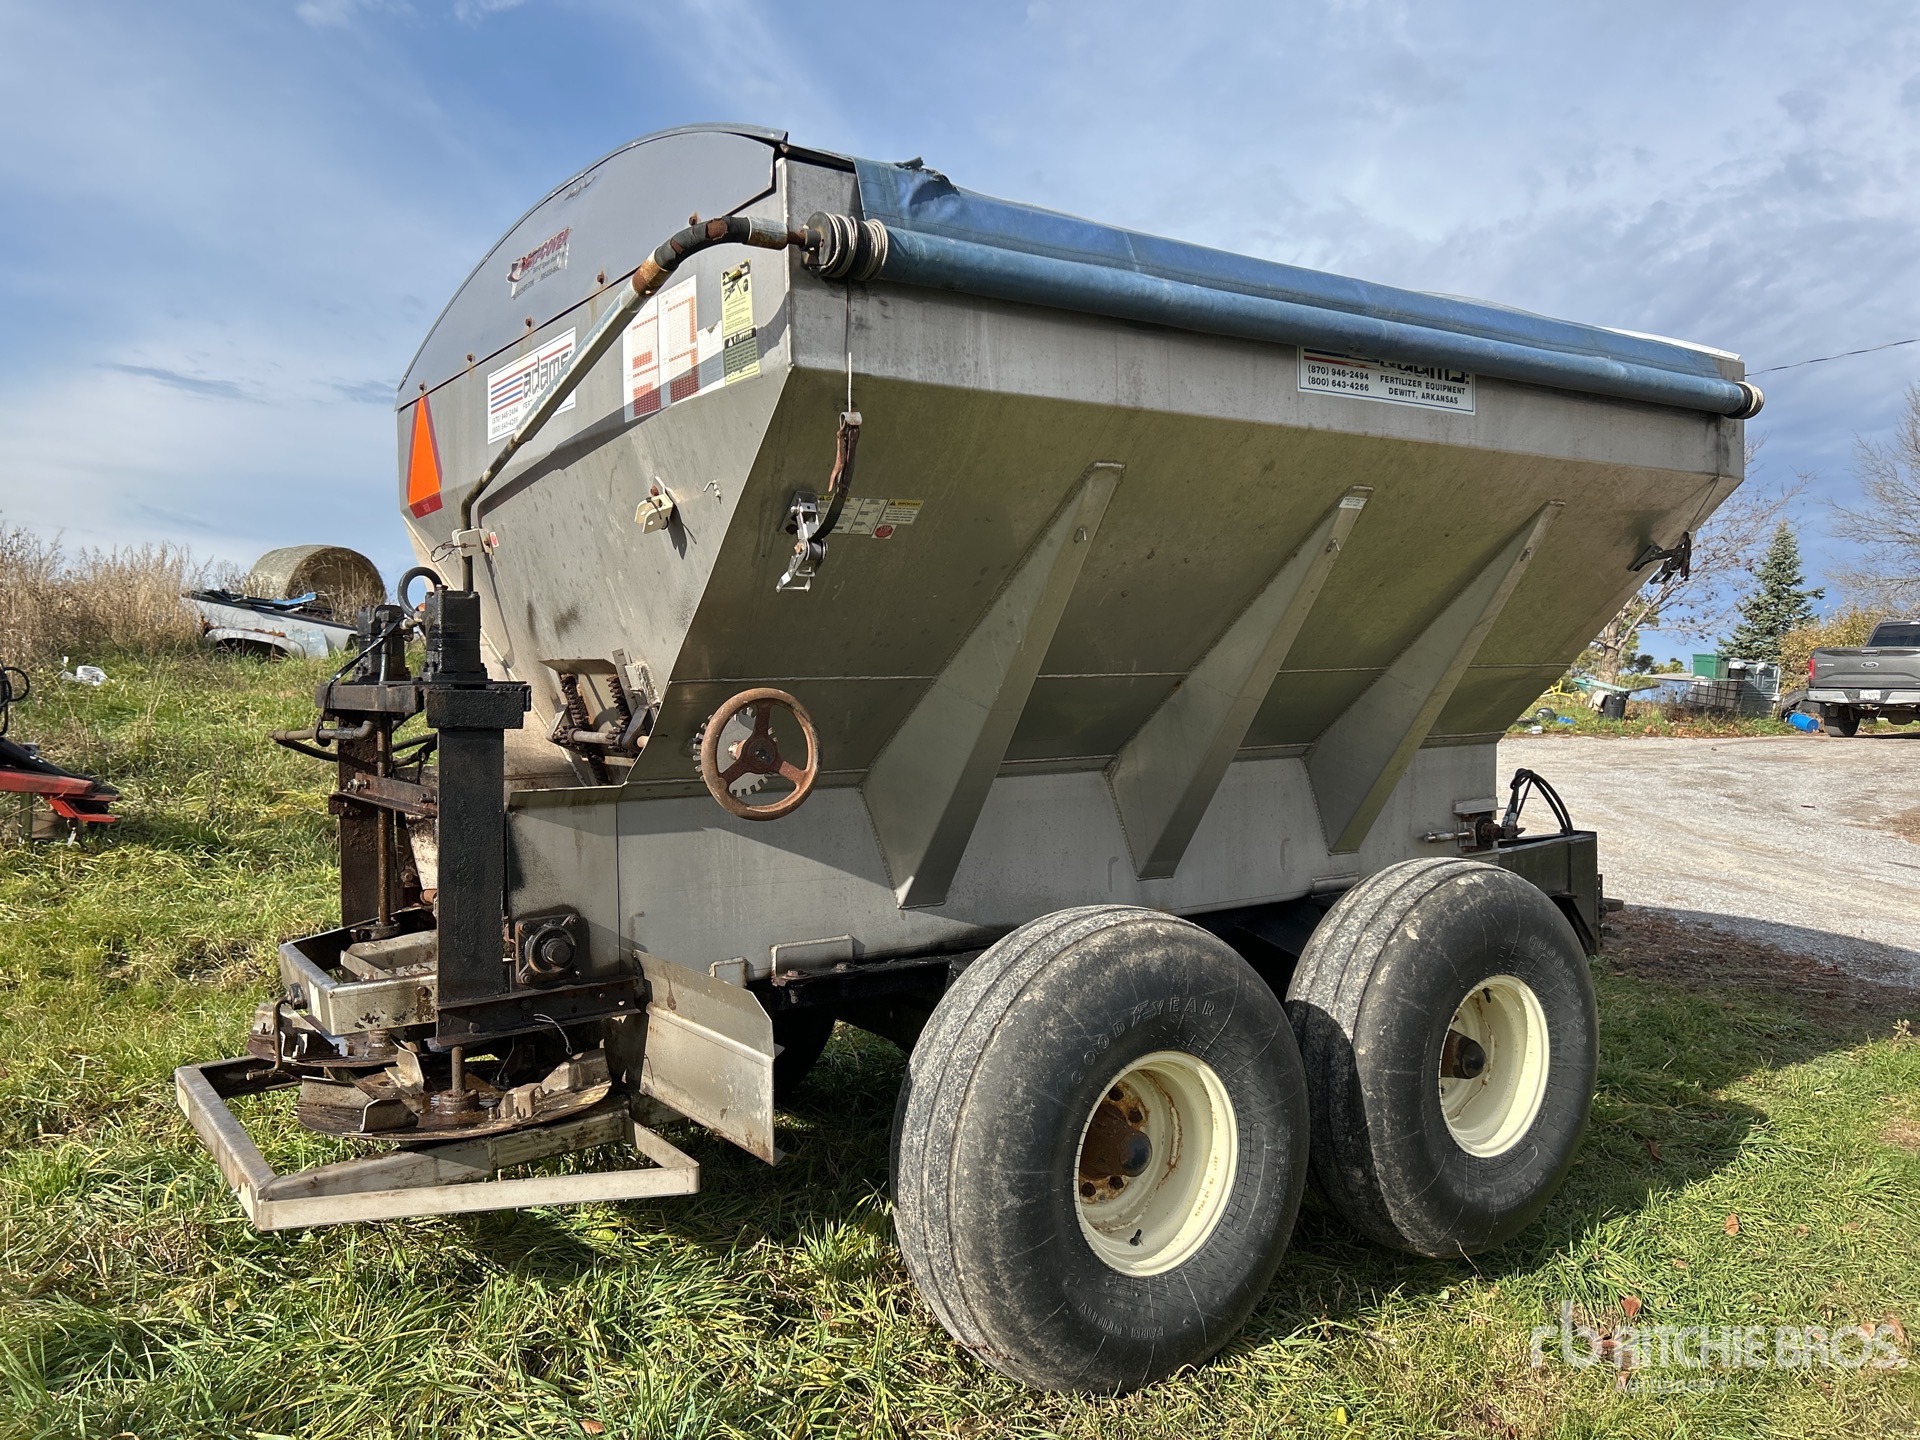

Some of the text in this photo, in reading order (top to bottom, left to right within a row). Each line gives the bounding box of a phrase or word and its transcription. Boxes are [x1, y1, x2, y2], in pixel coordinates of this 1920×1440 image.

[1307, 364, 1329, 375] (870)
[1331, 368, 1369, 380] 946-2494
[1308, 376, 1369, 391] (800) 643-4266
[1380, 375, 1466, 395] FERTILIZER EQUIPMENT
[1388, 387, 1458, 404] DEWITT, ARKANSAS
[1071, 997, 1215, 1085] GOODYEAR
